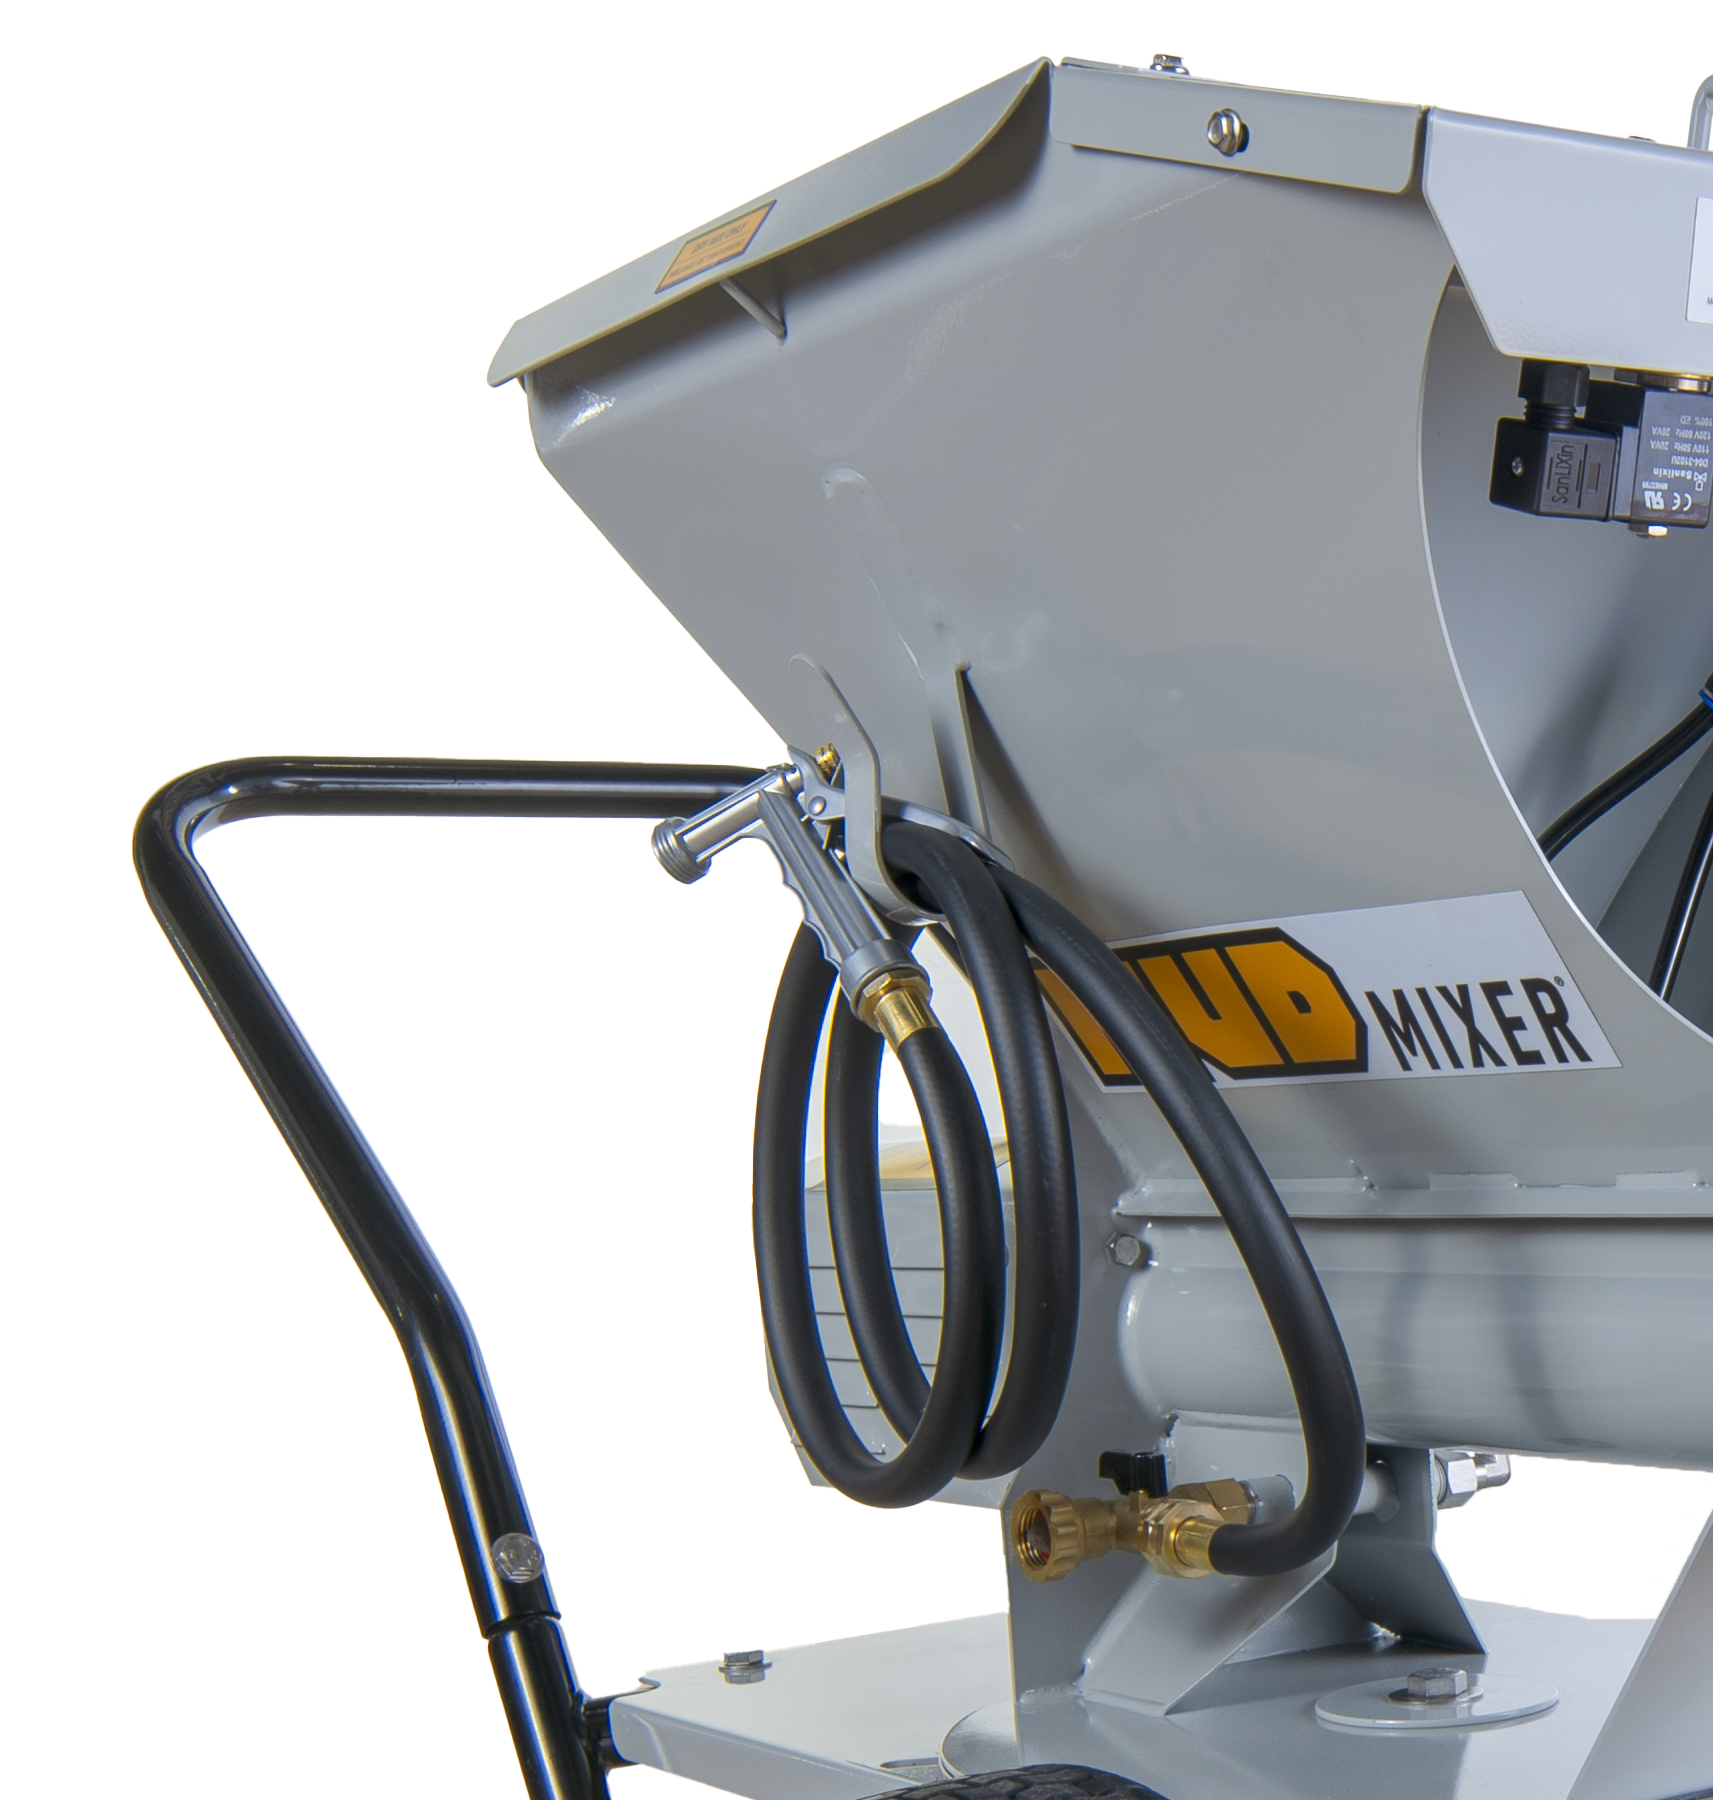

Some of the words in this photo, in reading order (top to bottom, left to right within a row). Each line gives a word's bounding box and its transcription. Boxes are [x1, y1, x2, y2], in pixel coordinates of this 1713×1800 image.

[1652, 426, 1670, 438] 20VA
[1675, 428, 1695, 440] 60Hz
[1695, 429, 1712, 440] 120V
[1650, 439, 1669, 451] 20VA
[1674, 441, 1694, 453] 50Hz
[1694, 442, 1710, 454] 110V
[1552, 444, 1575, 504] SanLiXin
[1653, 467, 1693, 480] Sanlixin
[1028, 926, 1368, 1085] UD
